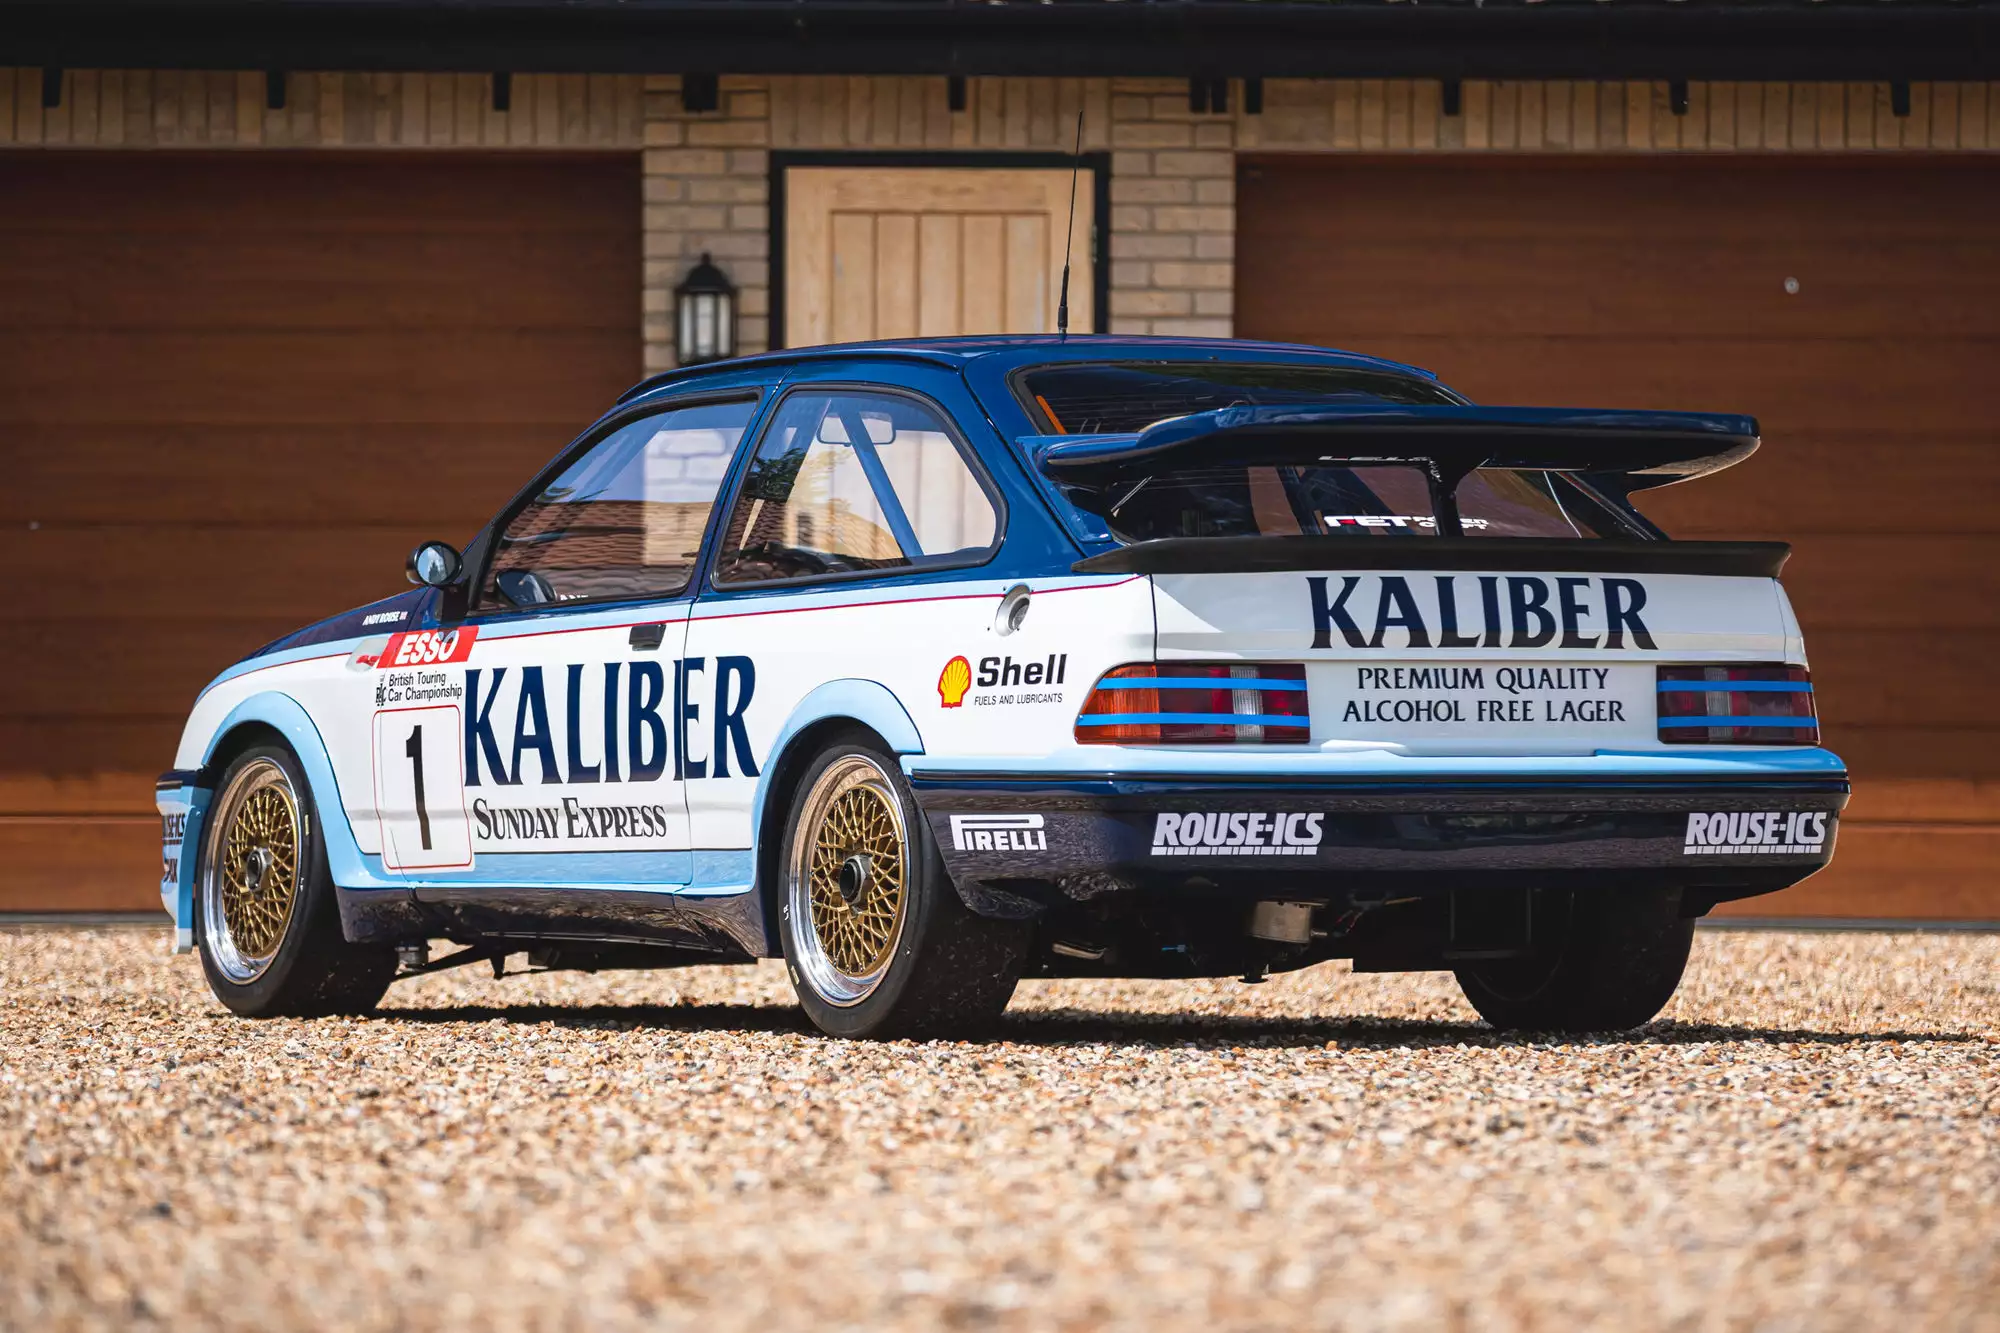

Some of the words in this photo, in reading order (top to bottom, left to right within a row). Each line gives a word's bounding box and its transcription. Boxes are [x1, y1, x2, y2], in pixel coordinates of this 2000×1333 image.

[1306, 575, 1659, 651] KALIBER
[394, 630, 460, 665] ESSO
[388, 671, 414, 687] British
[417, 670, 447, 686] Touring
[977, 653, 1067, 687] Shell
[1357, 667, 1485, 690] PREMIUM
[1495, 667, 1610, 695] QUALITY
[387, 688, 403, 702] Car
[405, 683, 463, 702] Championship
[974, 695, 997, 706] FUELS
[998, 694, 1014, 705] AND
[1016, 692, 1063, 705] LUBRICANTS
[464, 655, 760, 787] KALIBER
[1342, 699, 1466, 723] ALCOHOL
[1477, 700, 1535, 722] FREE
[1545, 699, 1627, 722] LAGER
[405, 724, 433, 850] 1
[949, 813, 1048, 851] PIRELLI
[1151, 812, 1325, 847] ROUSE-ICS
[1684, 812, 1827, 847] ROUSE-ICS
